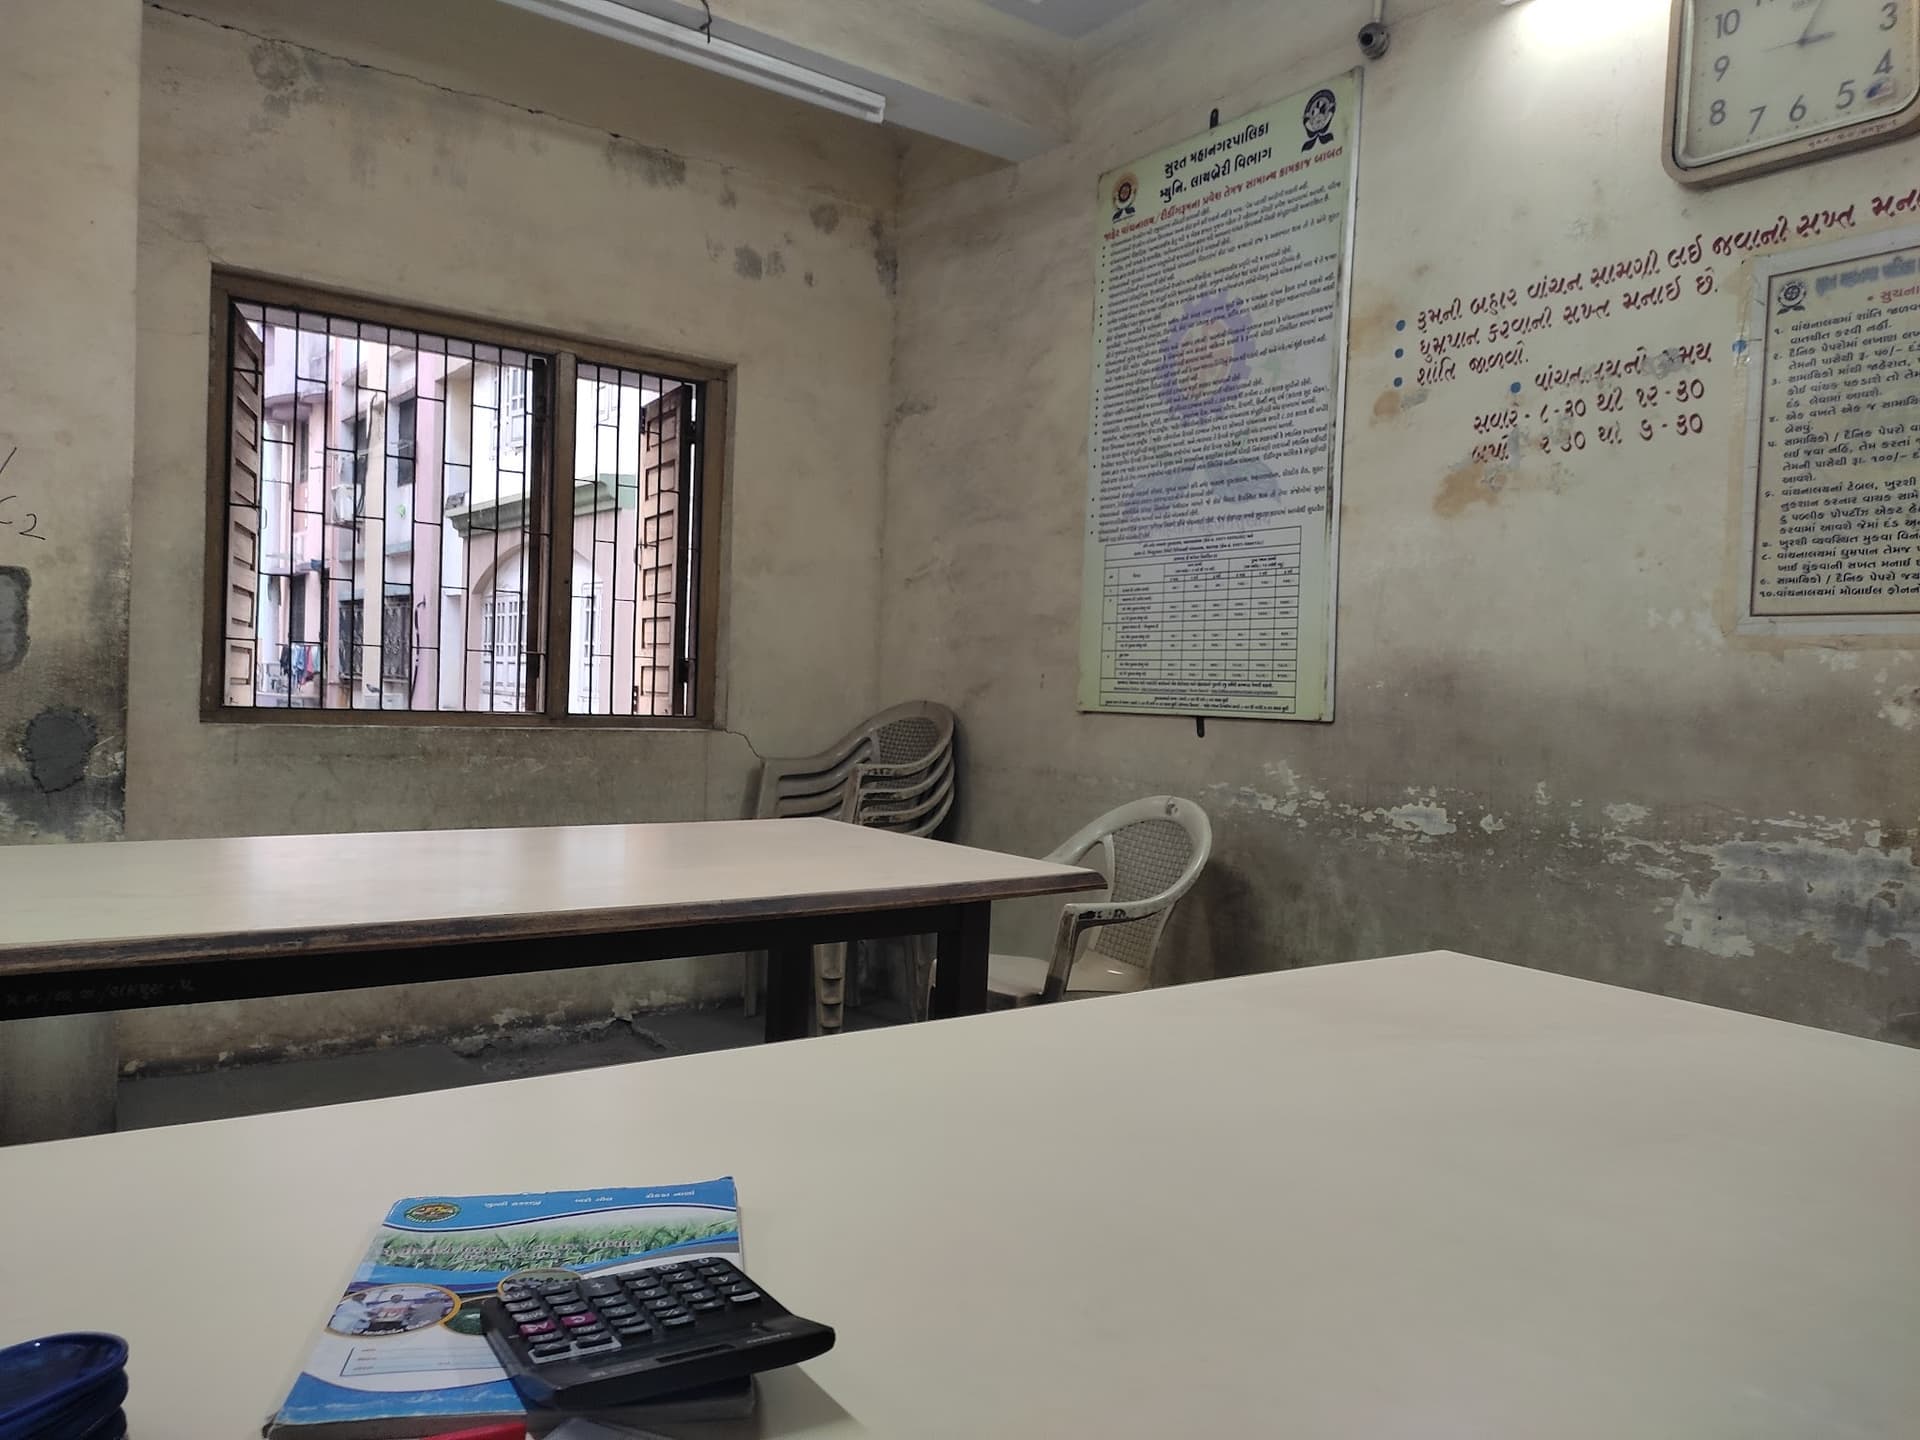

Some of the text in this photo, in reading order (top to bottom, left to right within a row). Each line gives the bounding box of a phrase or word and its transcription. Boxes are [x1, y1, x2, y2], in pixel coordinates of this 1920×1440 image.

[1716, 9, 1740, 39] 10
[1879, 2, 1897, 31] 3
[1714, 55, 1730, 82] 9
[1873, 48, 1894, 75] 4
[1789, 95, 1807, 123] 6
[1835, 80, 1855, 110] 5
[1709, 99, 1726, 126] 8
[1750, 105, 1767, 135] 7
[1165, 122, 1269, 179] સુરત મહાનગરપાલિકા
[1160, 147, 1272, 203] મ્યુનિ. લાયબ્રેરી વિભાગ
[1470, 288, 1517, 316] બહાર
[1527, 273, 1583, 299] વાંચન
[1713, 215, 1788, 256] જવાની
[1488, 306, 1552, 343] કરવાની
[1417, 356, 1456, 386] શાંતિ
[1886, 370, 1900, 382] તો
[1858, 440, 1876, 452] તેમ
[1820, 519, 1852, 532] આવશે
[1883, 544, 1911, 556] તેમજ
[1869, 571, 1896, 583] પેપરો
